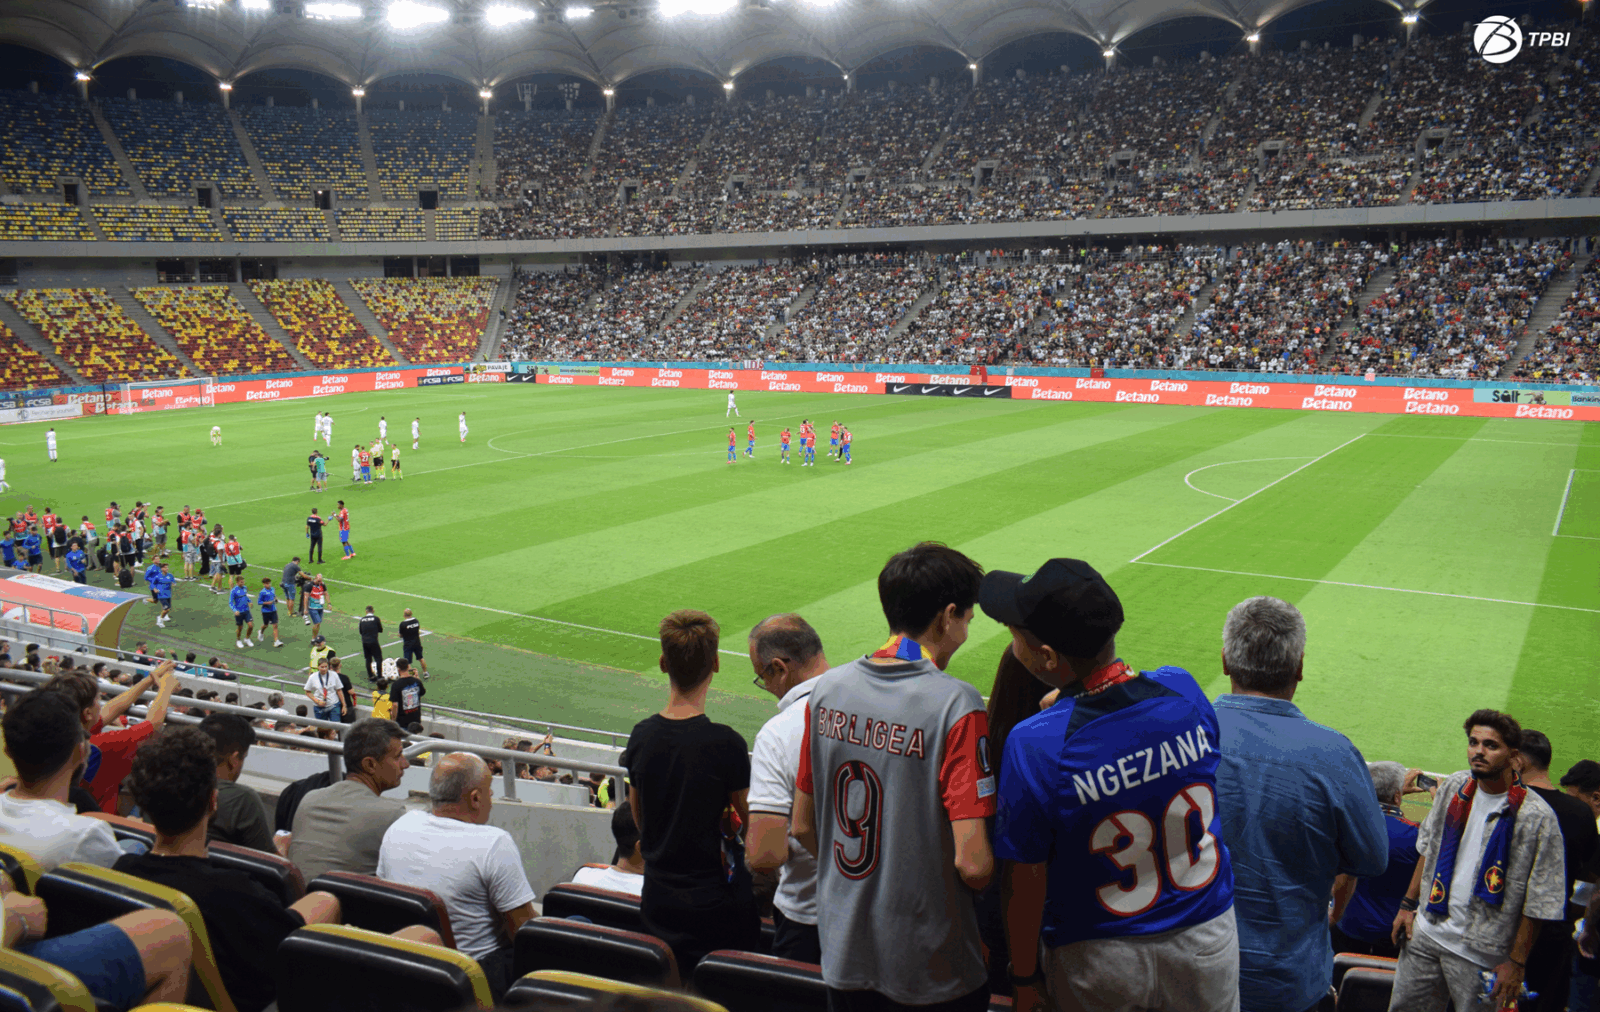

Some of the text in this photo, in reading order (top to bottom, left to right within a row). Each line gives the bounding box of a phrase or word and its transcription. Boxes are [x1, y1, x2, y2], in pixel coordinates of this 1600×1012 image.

[376, 372, 401, 381] Betano
[427, 368, 451, 377] Betano
[468, 373, 499, 382] Betano
[612, 368, 634, 377] Betano
[658, 369, 683, 378] Betano
[708, 370, 734, 379] Betano
[761, 371, 787, 381] Betano
[816, 372, 844, 382] Betano
[322, 375, 348, 384] Betano
[423, 377, 442, 385] FCSB
[447, 375, 464, 383] FCSB
[548, 375, 574, 384] Betano
[598, 376, 625, 386] Betano
[651, 378, 680, 387] Betano
[875, 373, 905, 384] Betano
[929, 374, 970, 385] Betano
[1005, 376, 1039, 387] Betano
[1076, 378, 1111, 389] Betano
[205, 384, 236, 393] Betano
[265, 380, 293, 389] Betano
[375, 381, 404, 389] Betano
[708, 379, 738, 389] Betano
[769, 381, 800, 391] Betano
[834, 383, 868, 393] Betano
[1150, 380, 1188, 392] Betano
[1229, 382, 1270, 395] Betano
[142, 389, 173, 399] Betano
[246, 390, 280, 400] Betano
[313, 385, 345, 395] Betano
[1032, 388, 1072, 400] Betano
[1314, 384, 1357, 398] Betano
[1403, 387, 1449, 401] Betano
[1115, 391, 1160, 403] Betano
[1205, 394, 1253, 406] Betano
[1302, 397, 1353, 411] Betano
[1405, 401, 1459, 415] Betano
[1514, 404, 1573, 419] Betano
[817, 706, 925, 761] BIRLIGEA
[1072, 724, 1213, 805] NGEZANA
[833, 759, 884, 881] 9
[1088, 781, 1221, 918] 30
